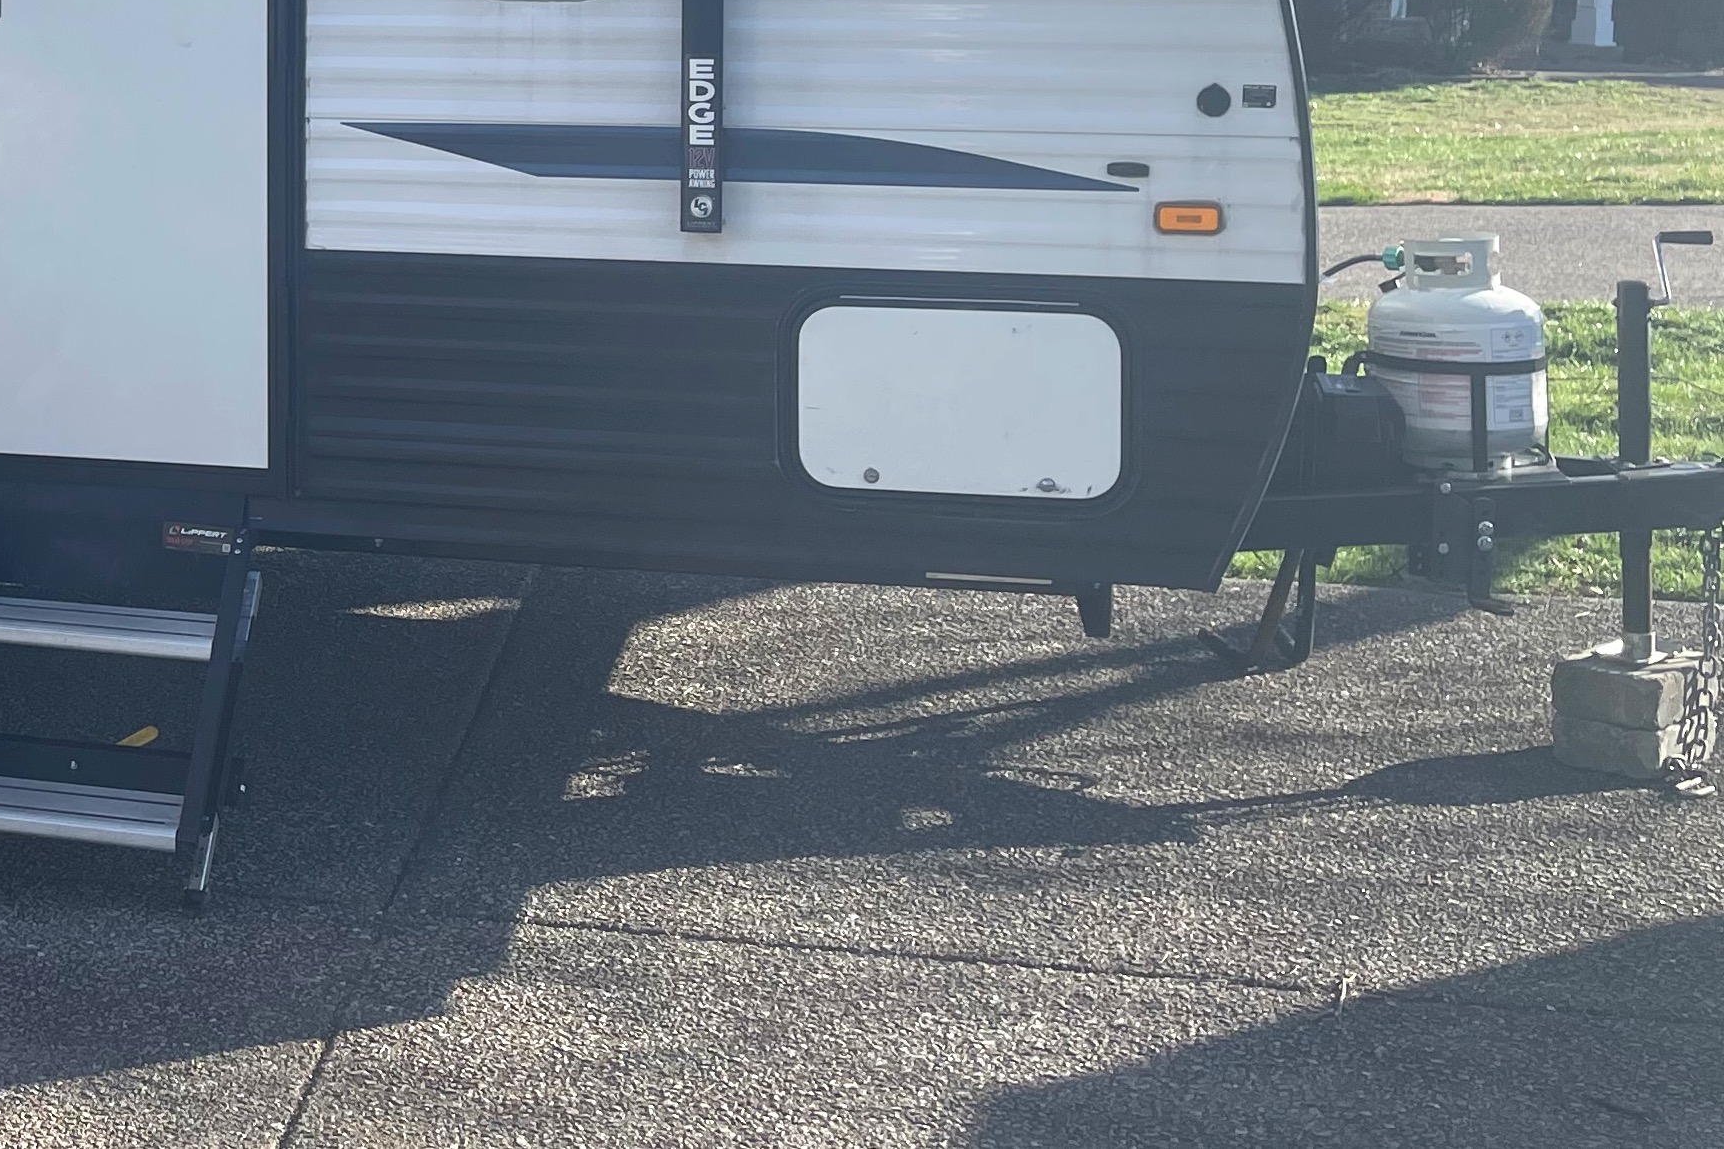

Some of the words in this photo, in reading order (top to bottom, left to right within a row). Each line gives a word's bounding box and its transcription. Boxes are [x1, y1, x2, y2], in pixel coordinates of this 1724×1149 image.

[688, 58, 716, 146] EDGE
[688, 168, 715, 179] POWER
[180, 528, 227, 538] LIPPERT
